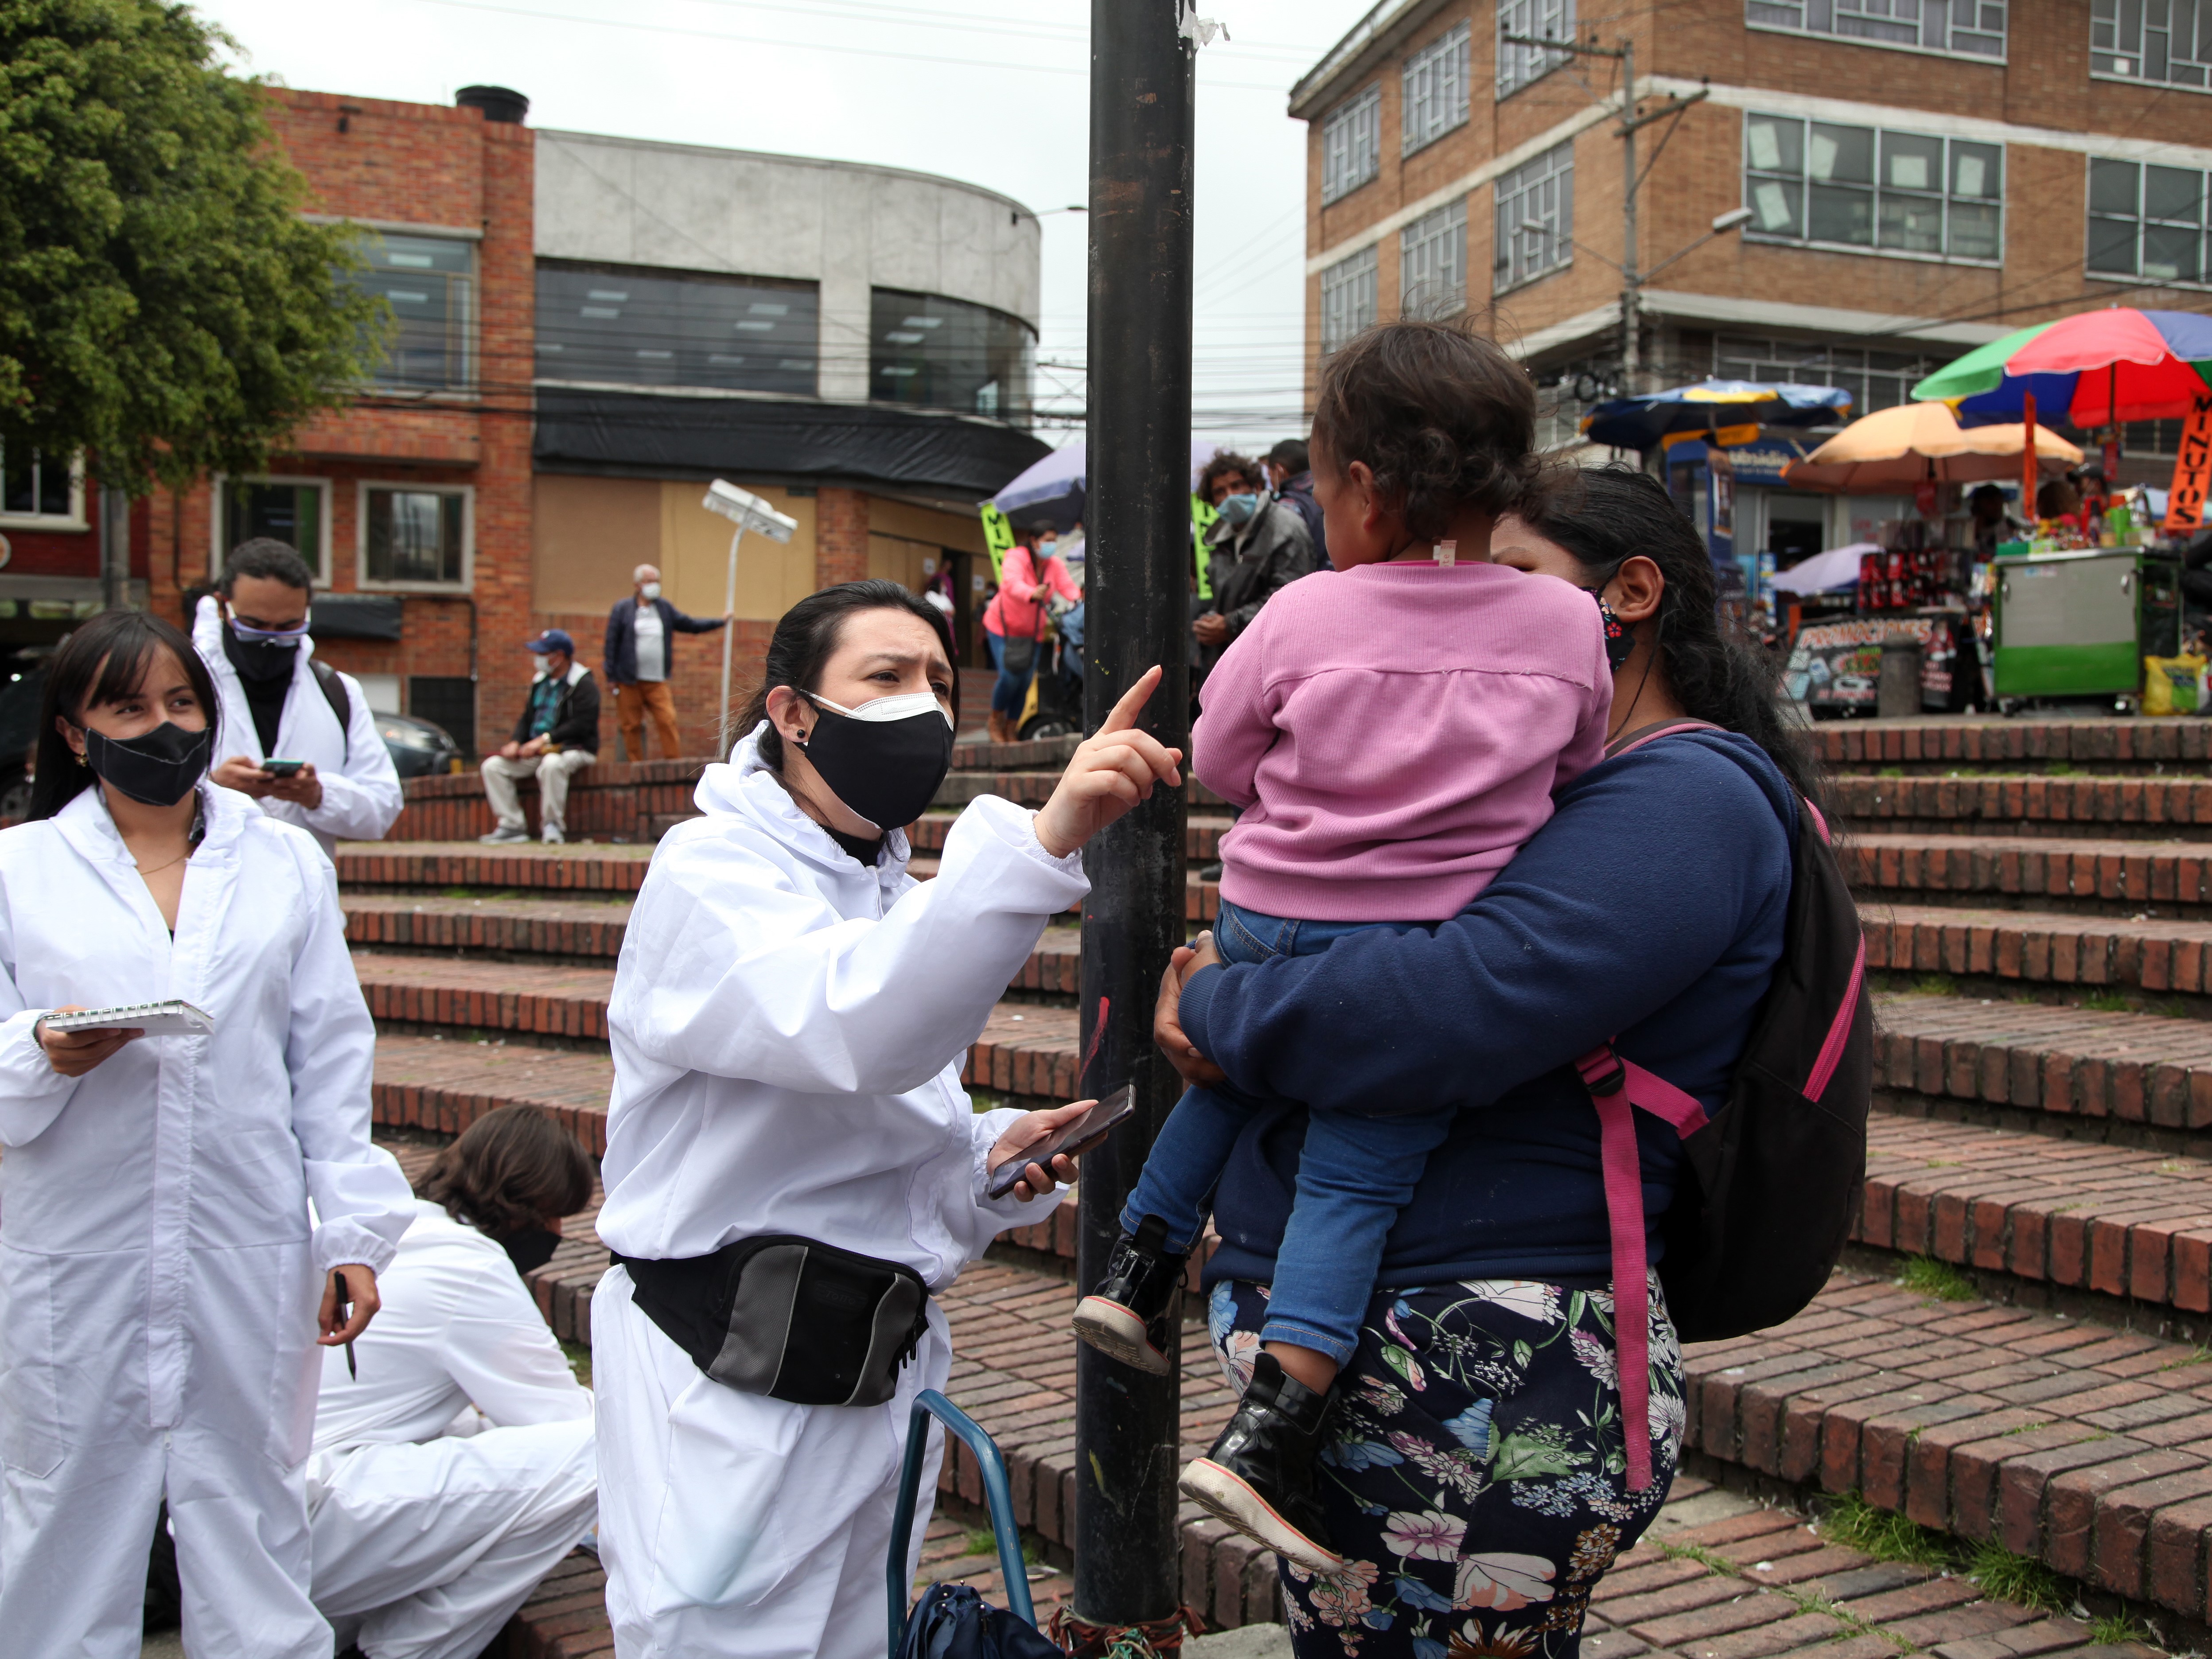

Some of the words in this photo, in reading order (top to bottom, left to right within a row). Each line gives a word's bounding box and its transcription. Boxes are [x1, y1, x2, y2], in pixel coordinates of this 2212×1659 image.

[2173, 395, 2212, 524] MINUTOS
[988, 513, 1009, 565] MIN
[826, 1290, 856, 1305] TOTTO
